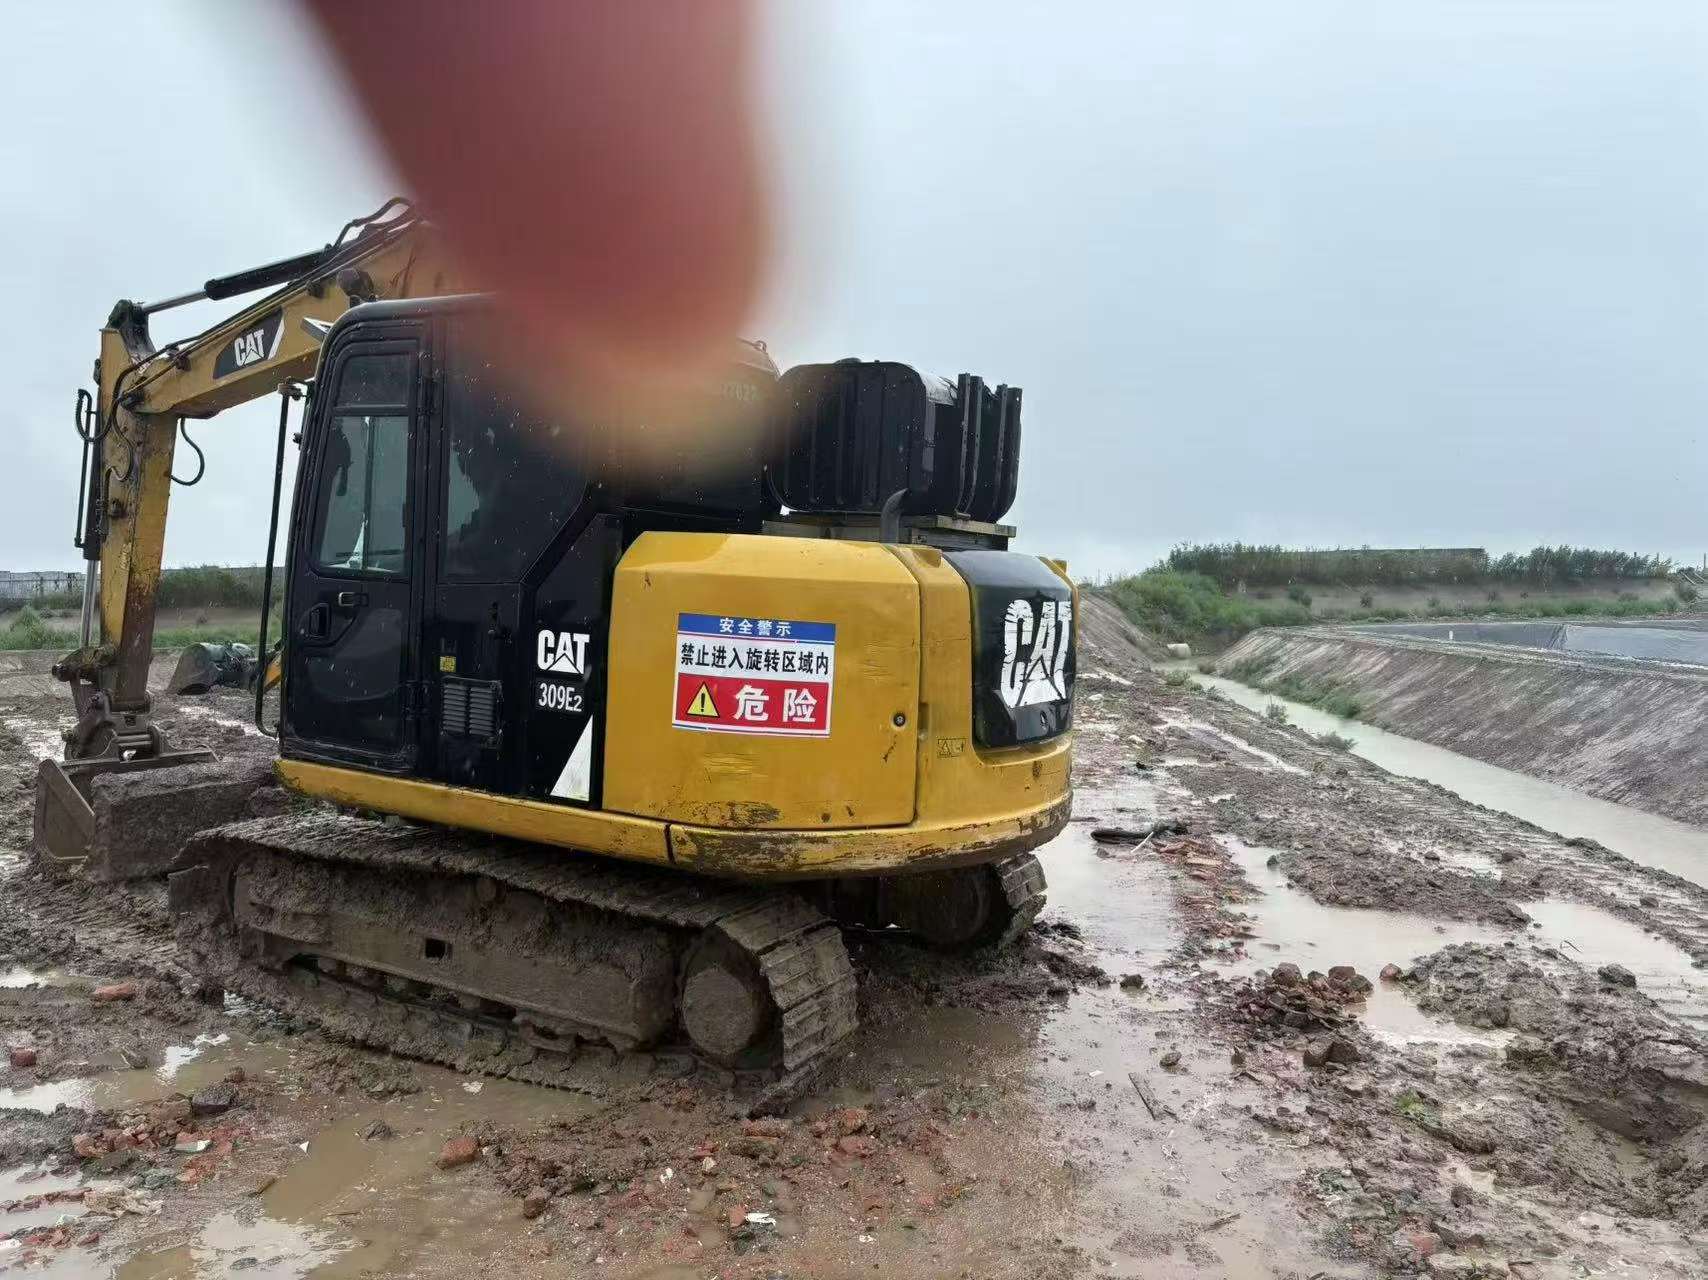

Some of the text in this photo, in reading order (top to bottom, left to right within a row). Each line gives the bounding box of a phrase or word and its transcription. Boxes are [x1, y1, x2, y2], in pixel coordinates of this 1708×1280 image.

[234, 329, 264, 367] CAT
[719, 618, 792, 637] 安全警示
[537, 629, 590, 674] CAT
[680, 643, 829, 675] 禁止进入旋转区域内
[1001, 599, 1072, 708] CAT
[538, 682, 582, 712] 309E2
[733, 684, 818, 723] 危险
